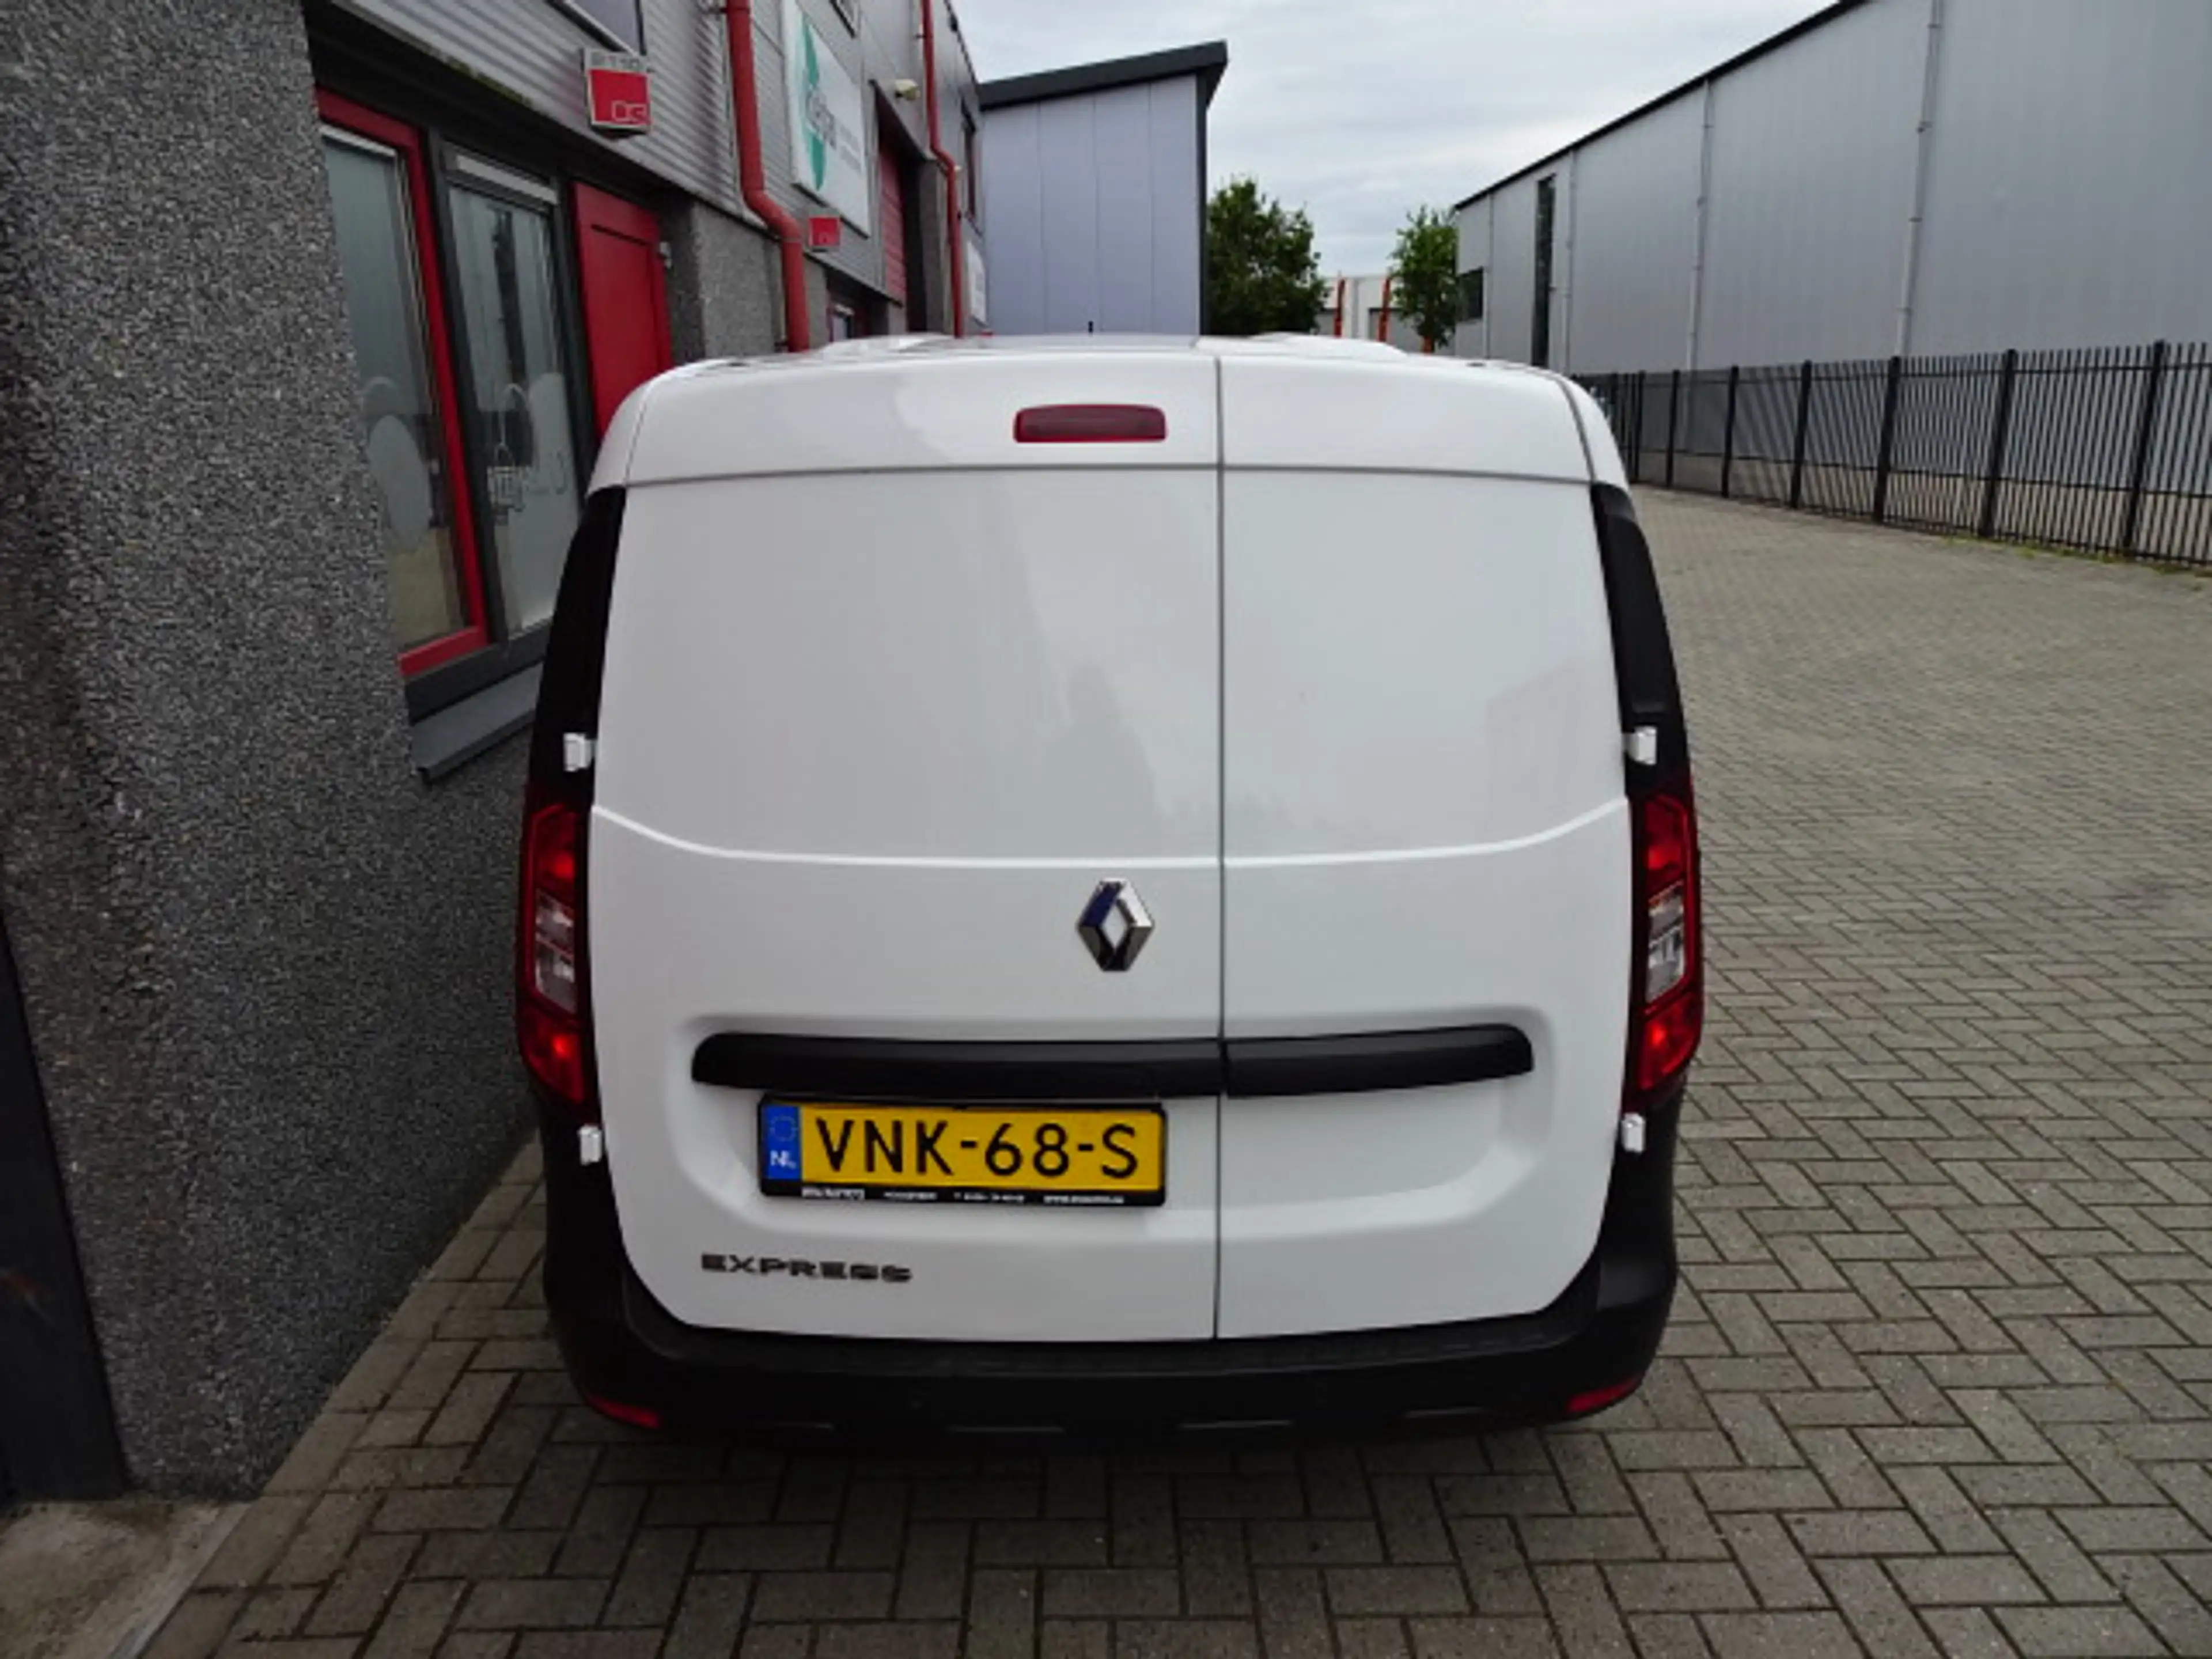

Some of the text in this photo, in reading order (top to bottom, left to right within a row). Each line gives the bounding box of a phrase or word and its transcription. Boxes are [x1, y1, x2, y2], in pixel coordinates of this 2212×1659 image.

[770, 1150, 797, 1170] NL
[815, 1116, 1138, 1179] VNK-68-S
[701, 1252, 914, 1284] EXPRESS
